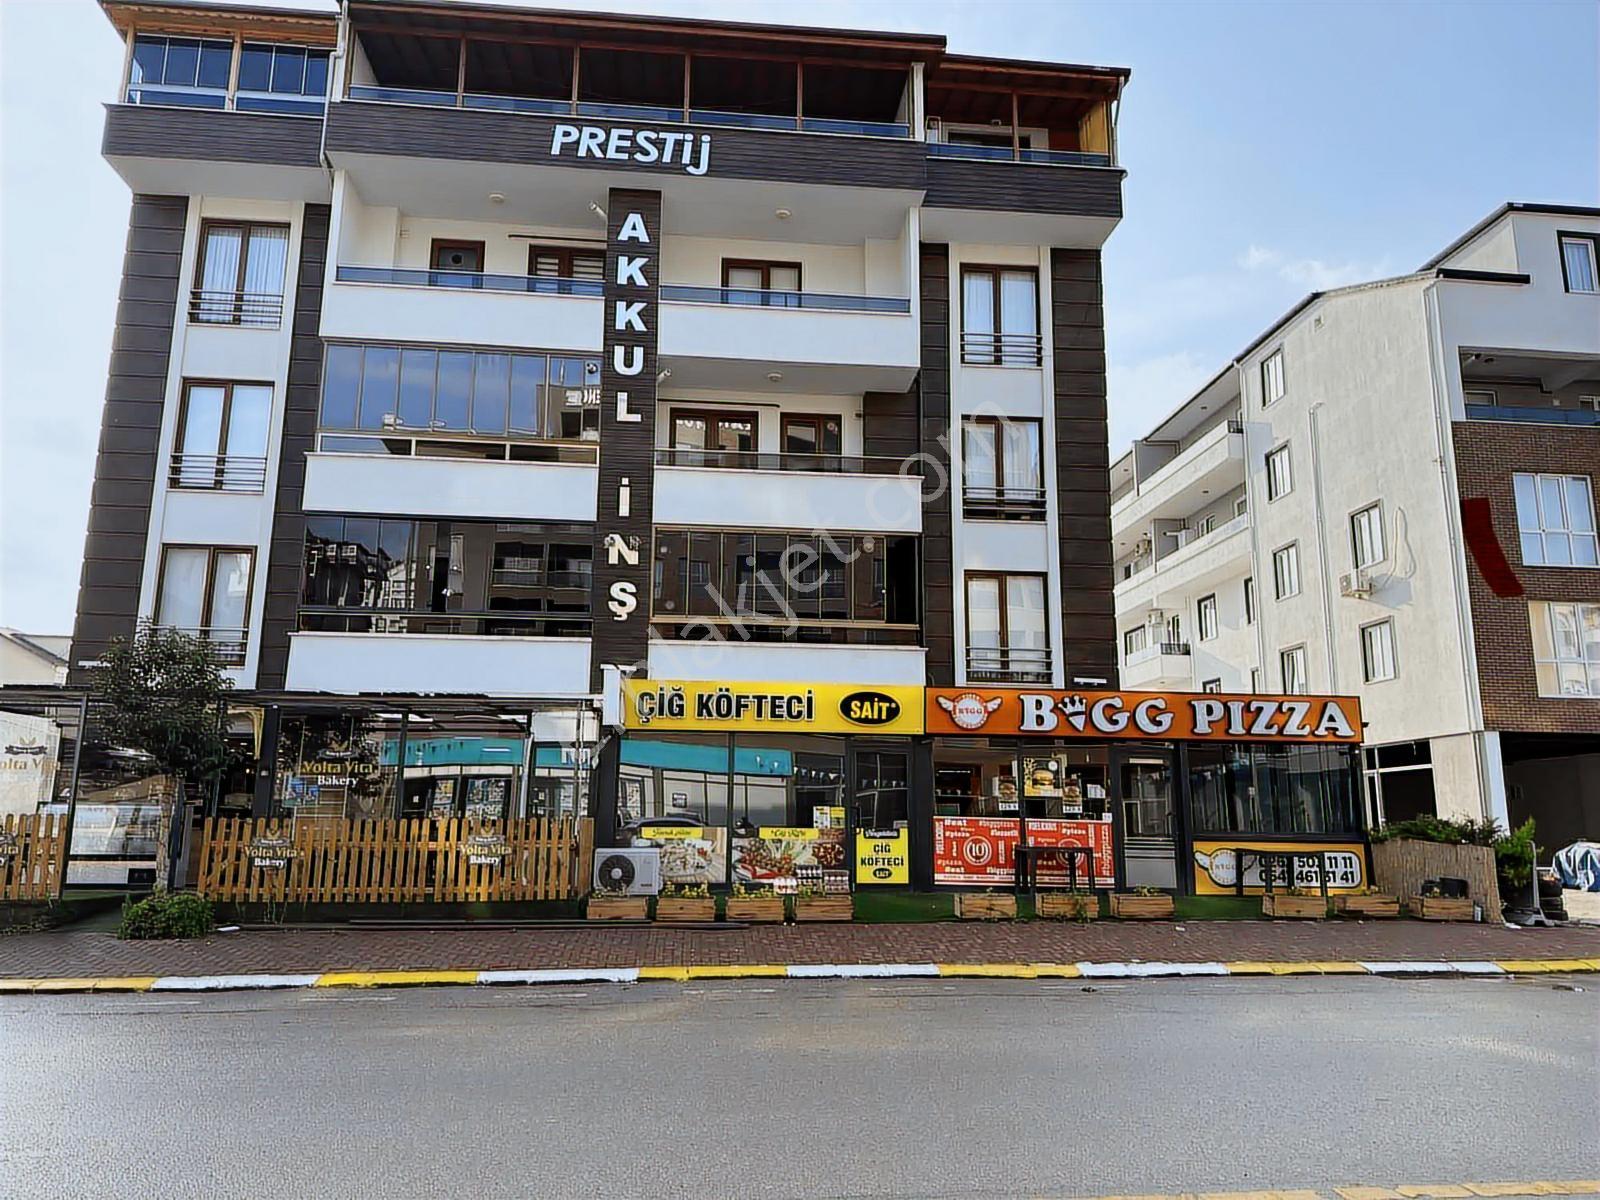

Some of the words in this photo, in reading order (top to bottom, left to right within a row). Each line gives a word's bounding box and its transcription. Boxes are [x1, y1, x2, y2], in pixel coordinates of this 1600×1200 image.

[613, 212, 650, 422] AKKUL
[636, 686, 685, 723] ÇİĞ
[697, 687, 814, 722] KÖFTECİ
[1190, 699, 1356, 737] PIZZA
[317, 775, 360, 789] Bakery
[1258, 854, 1290, 868] 026
[1327, 856, 1338, 869] 11
[1342, 856, 1353, 869] 11
[1296, 869, 1319, 883] 461
[1340, 870, 1355, 883] 41
